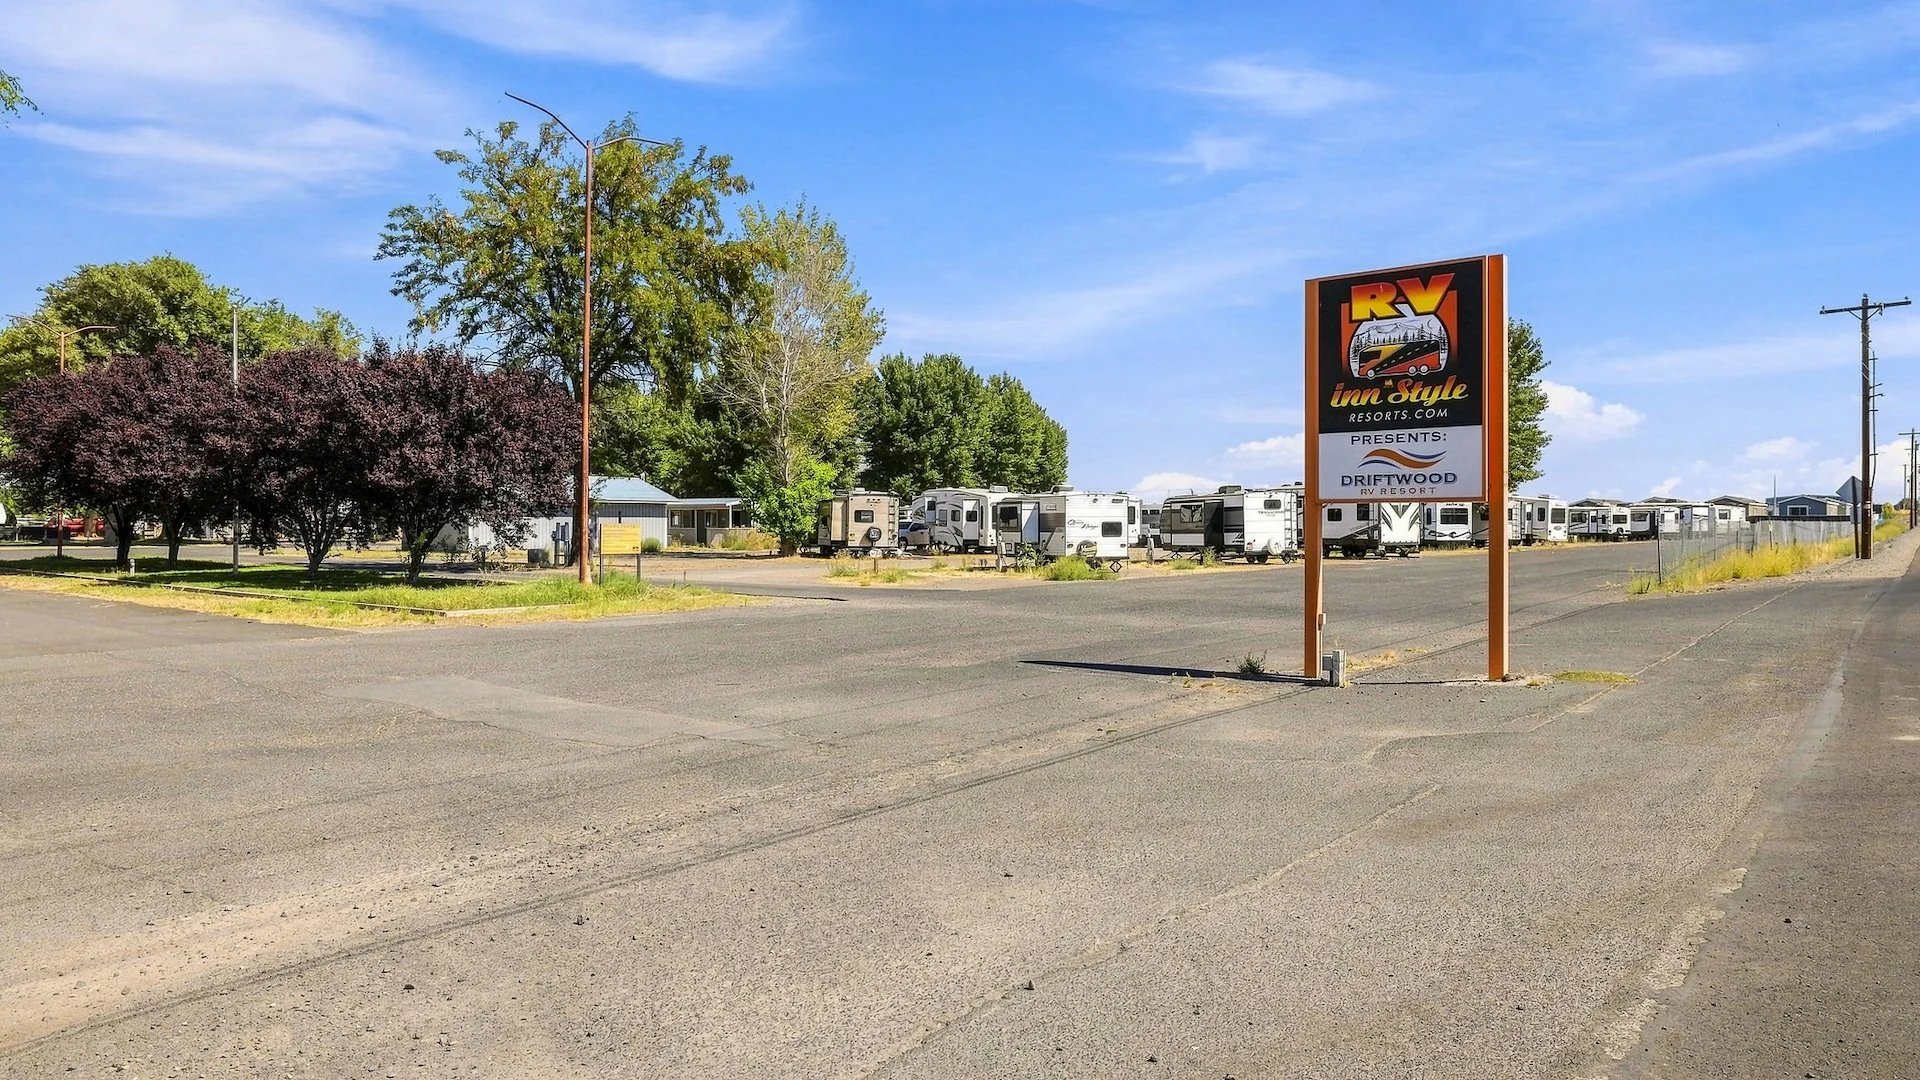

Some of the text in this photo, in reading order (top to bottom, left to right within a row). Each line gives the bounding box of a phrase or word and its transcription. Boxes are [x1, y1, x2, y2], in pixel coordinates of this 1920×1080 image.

[1351, 273, 1455, 321] RV
[1331, 375, 1469, 408] inn Style
[1348, 408, 1448, 423] RESORTS.COM
[1350, 431, 1447, 446] PRESENTS:
[1341, 473, 1457, 487] DRIFTWOOD
[1380, 487, 1437, 495] RESORT
